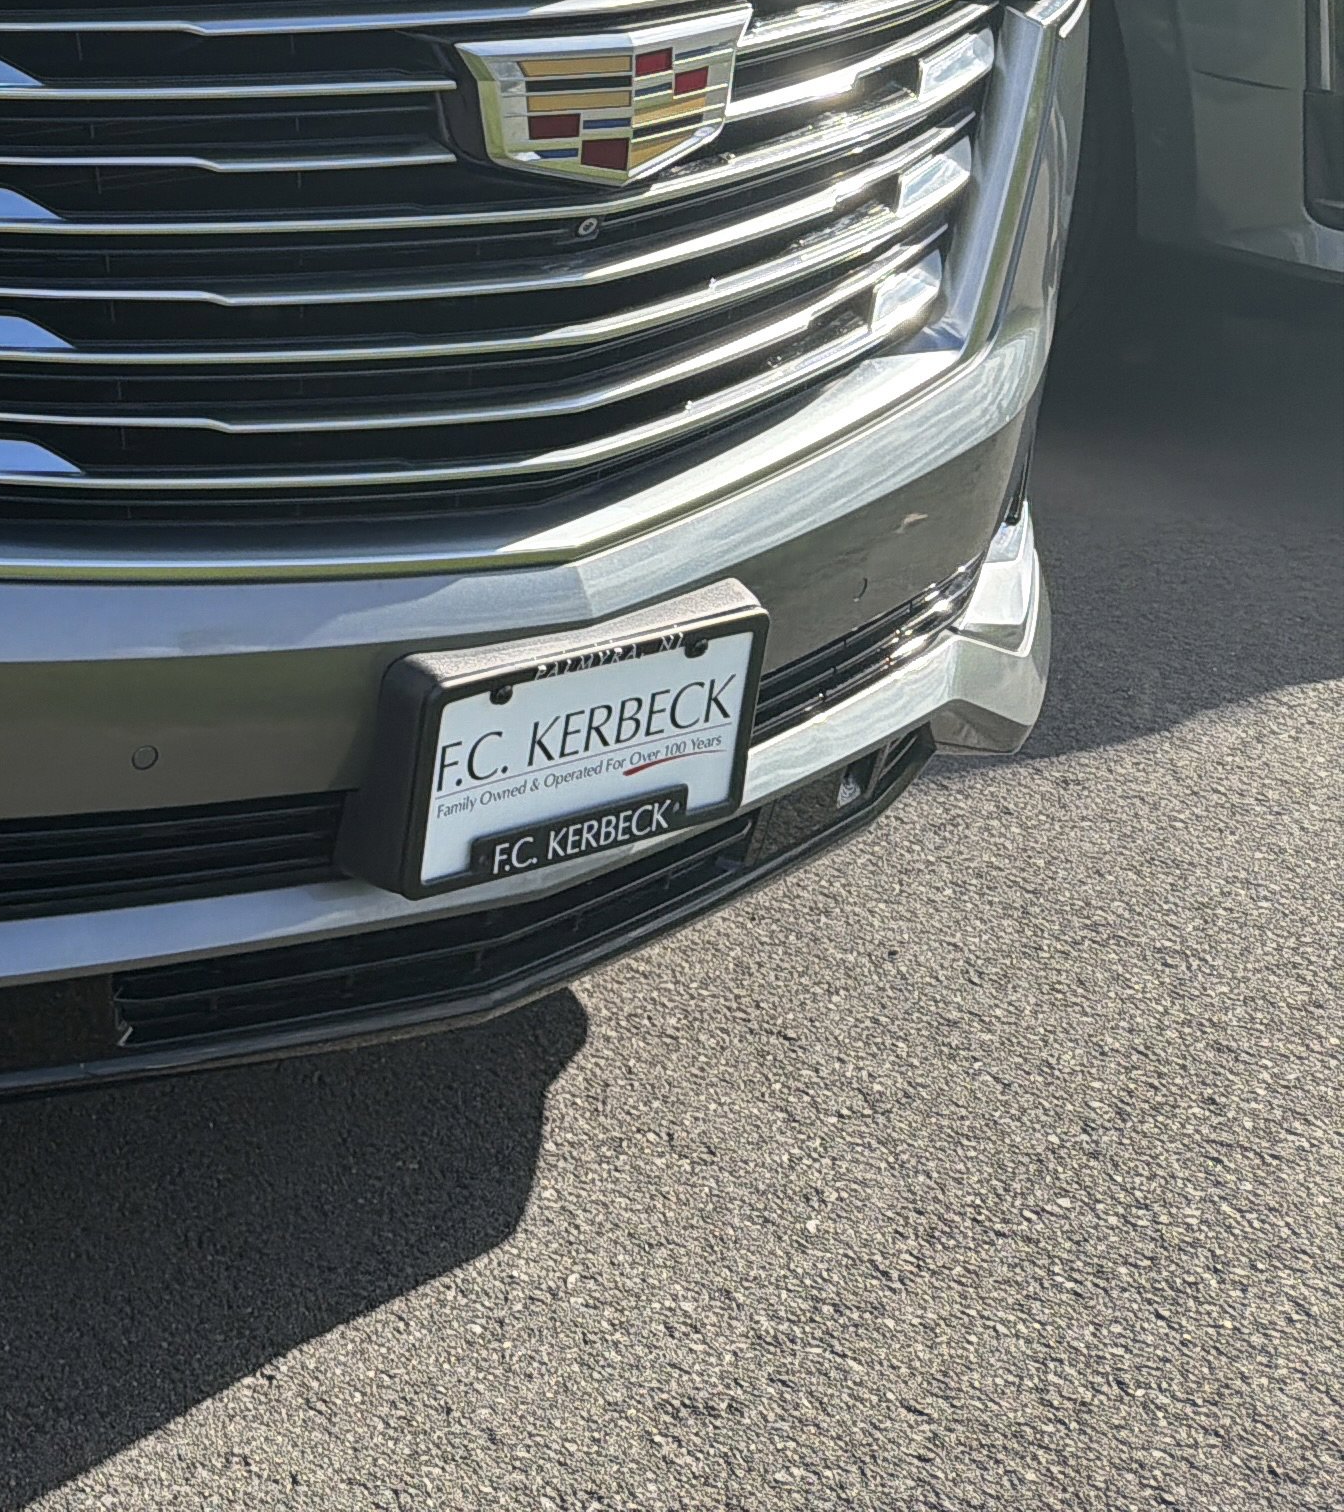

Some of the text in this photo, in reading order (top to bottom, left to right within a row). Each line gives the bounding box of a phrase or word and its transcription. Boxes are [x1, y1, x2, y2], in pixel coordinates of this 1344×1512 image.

[436, 674, 736, 792] F.C. KERBECK
[437, 735, 722, 819] Family Owned & Operated For Over 100 Years
[492, 799, 672, 875] F.C. KERBECK
